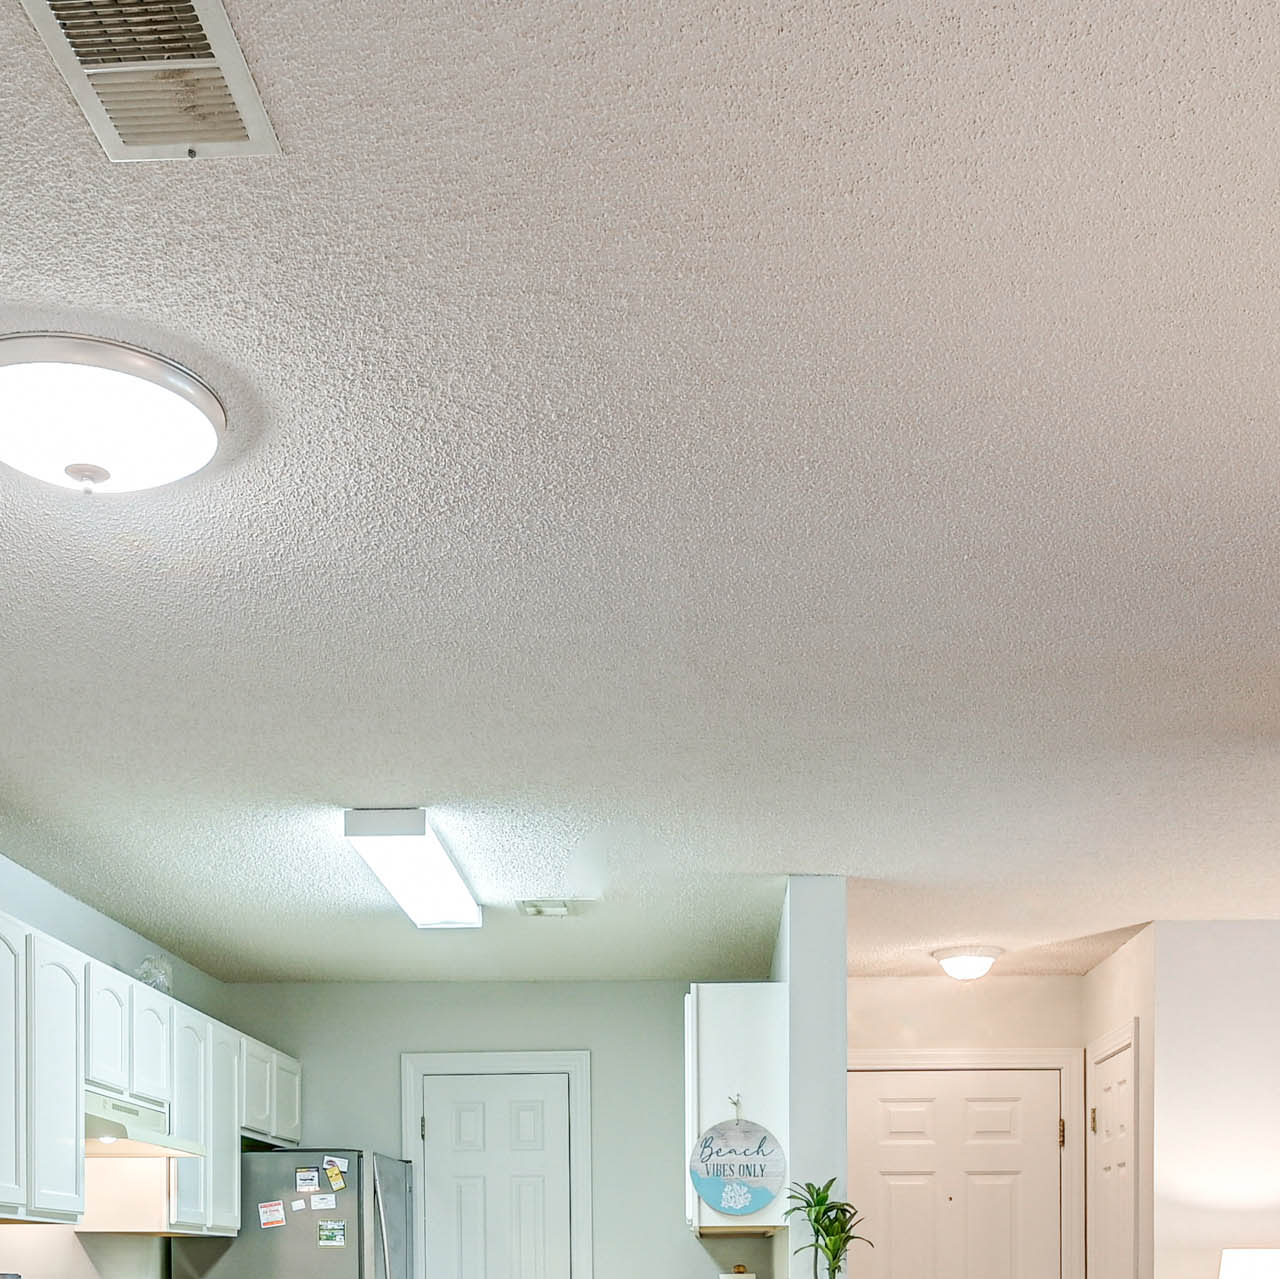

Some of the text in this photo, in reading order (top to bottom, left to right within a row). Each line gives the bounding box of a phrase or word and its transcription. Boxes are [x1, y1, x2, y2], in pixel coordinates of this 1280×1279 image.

[700, 1136, 775, 1163] Beach
[705, 1163, 767, 1177] VIBES ONLY
